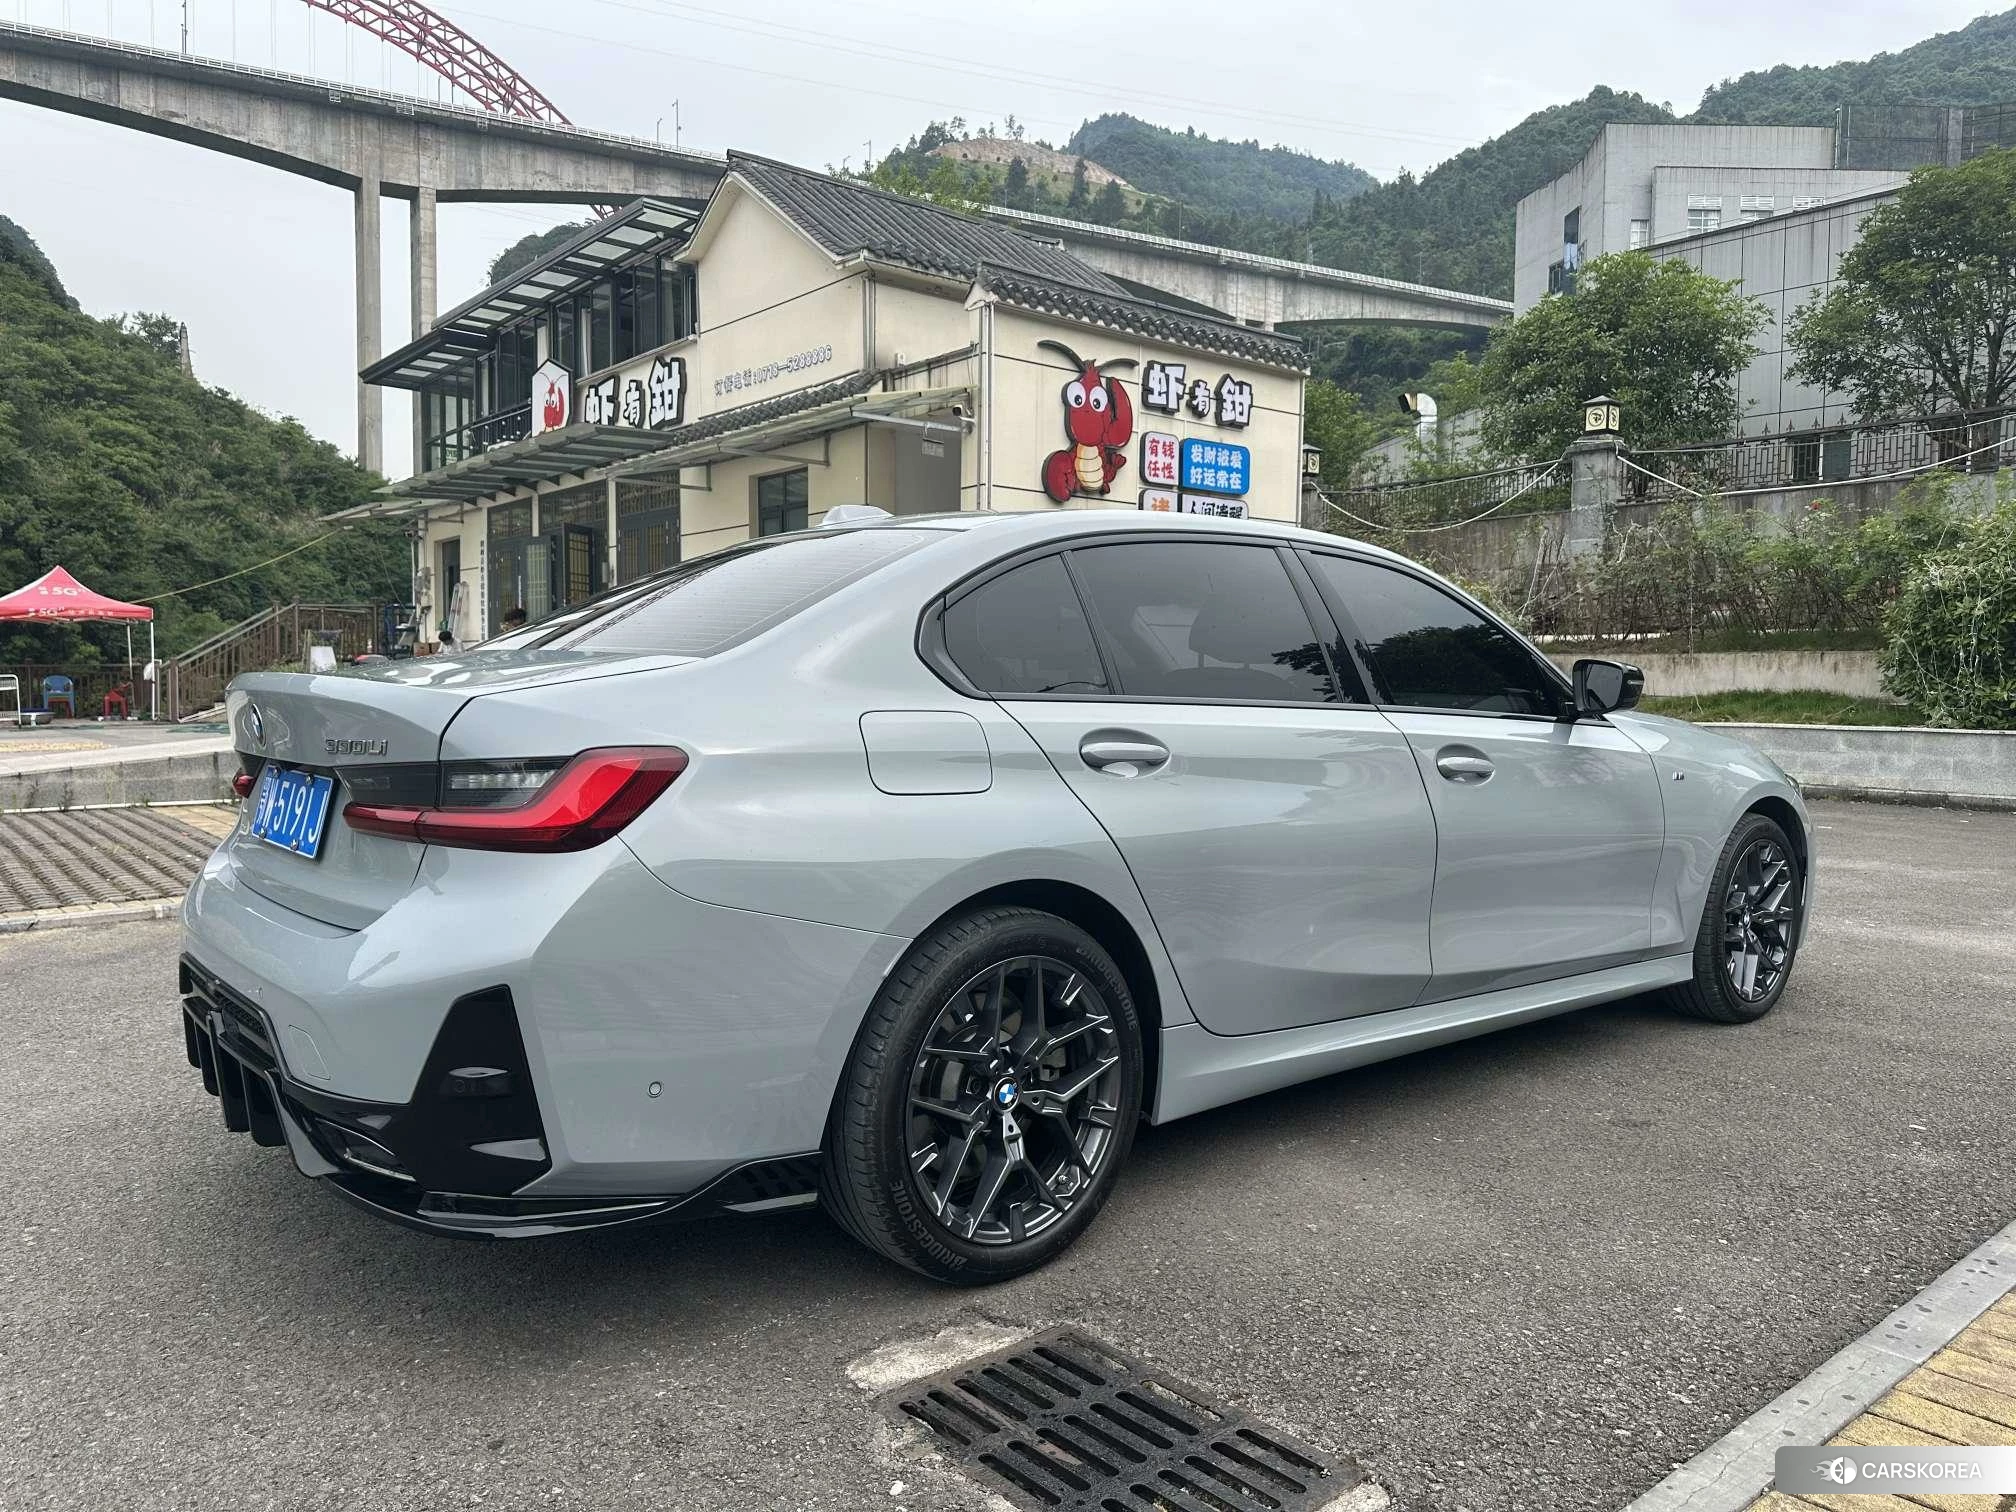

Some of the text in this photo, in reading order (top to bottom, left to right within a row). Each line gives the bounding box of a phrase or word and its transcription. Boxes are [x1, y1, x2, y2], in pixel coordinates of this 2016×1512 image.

[1148, 438, 1175, 460] 有钱
[1190, 444, 1243, 469] 发财被爱
[1147, 460, 1175, 480] 任性
[1190, 466, 1242, 490] 好运常在
